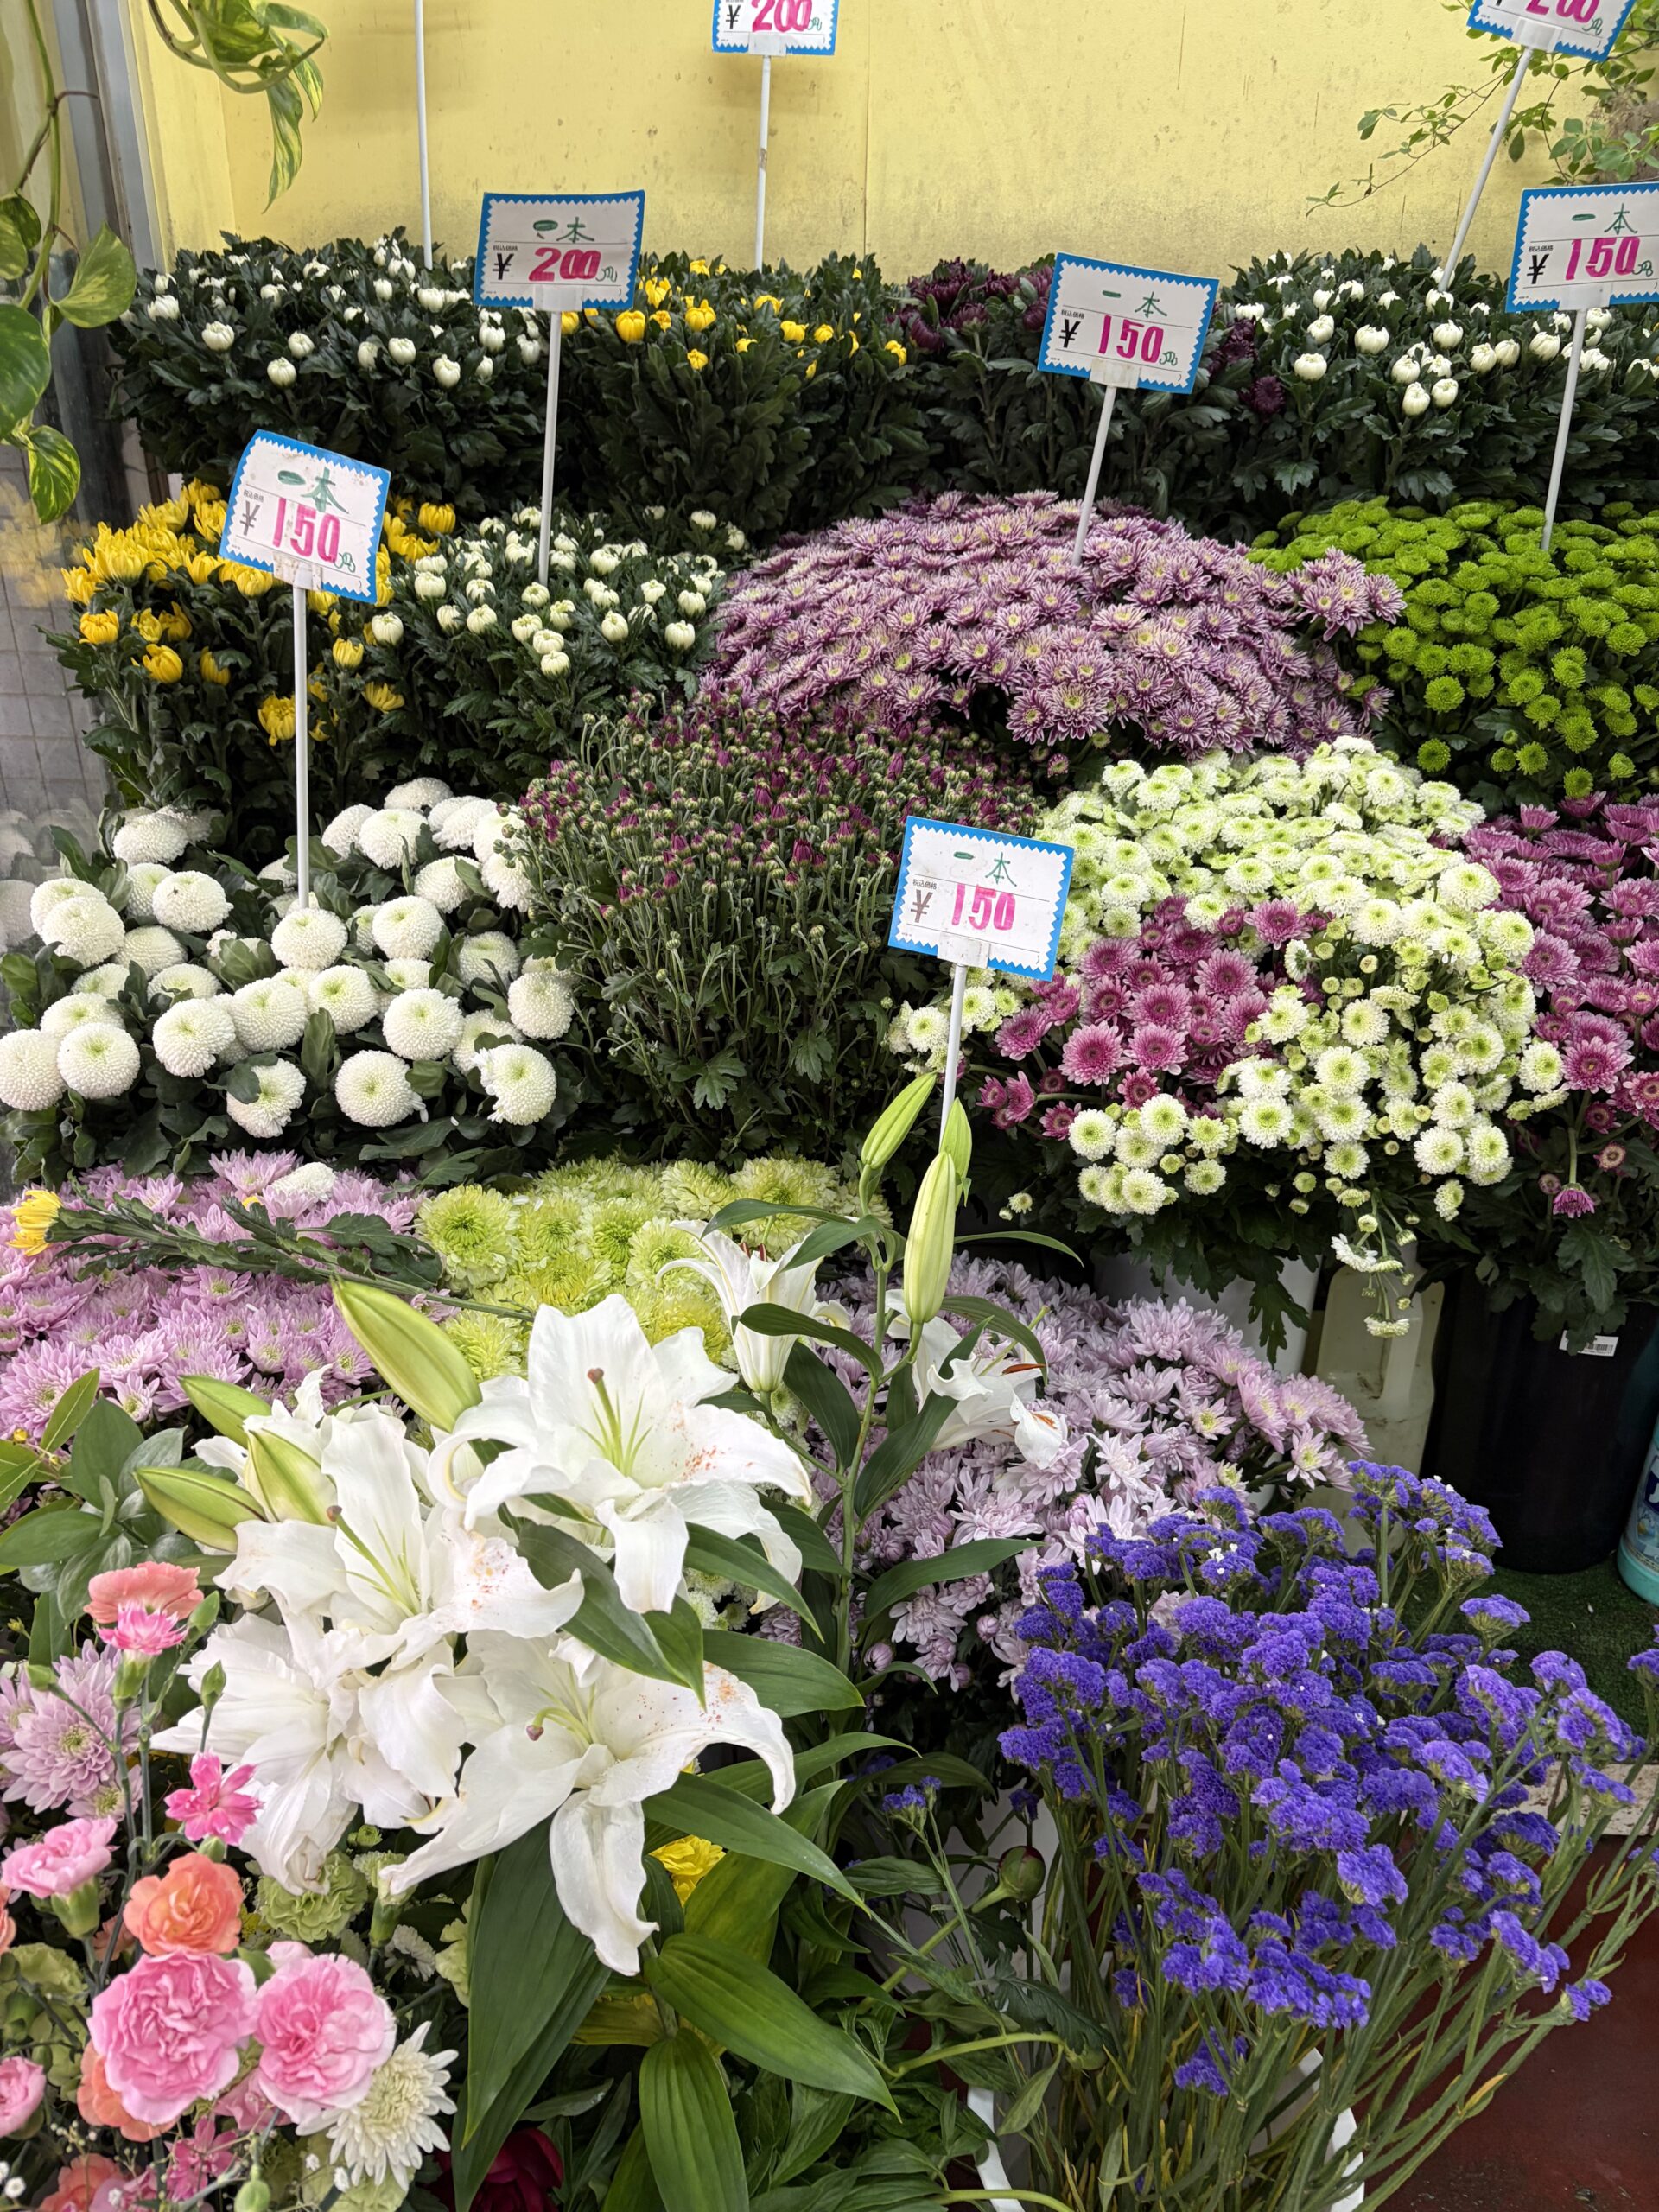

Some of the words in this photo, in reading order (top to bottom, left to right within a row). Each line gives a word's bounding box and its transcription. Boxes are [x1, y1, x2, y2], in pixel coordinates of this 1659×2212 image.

[532, 216, 595, 244] 一本
[1572, 203, 1638, 235] 一本
[1102, 290, 1168, 319] 一本
[277, 466, 350, 515] 一本
[953, 851, 1018, 887] 一本
[951, 882, 1016, 931] 150
